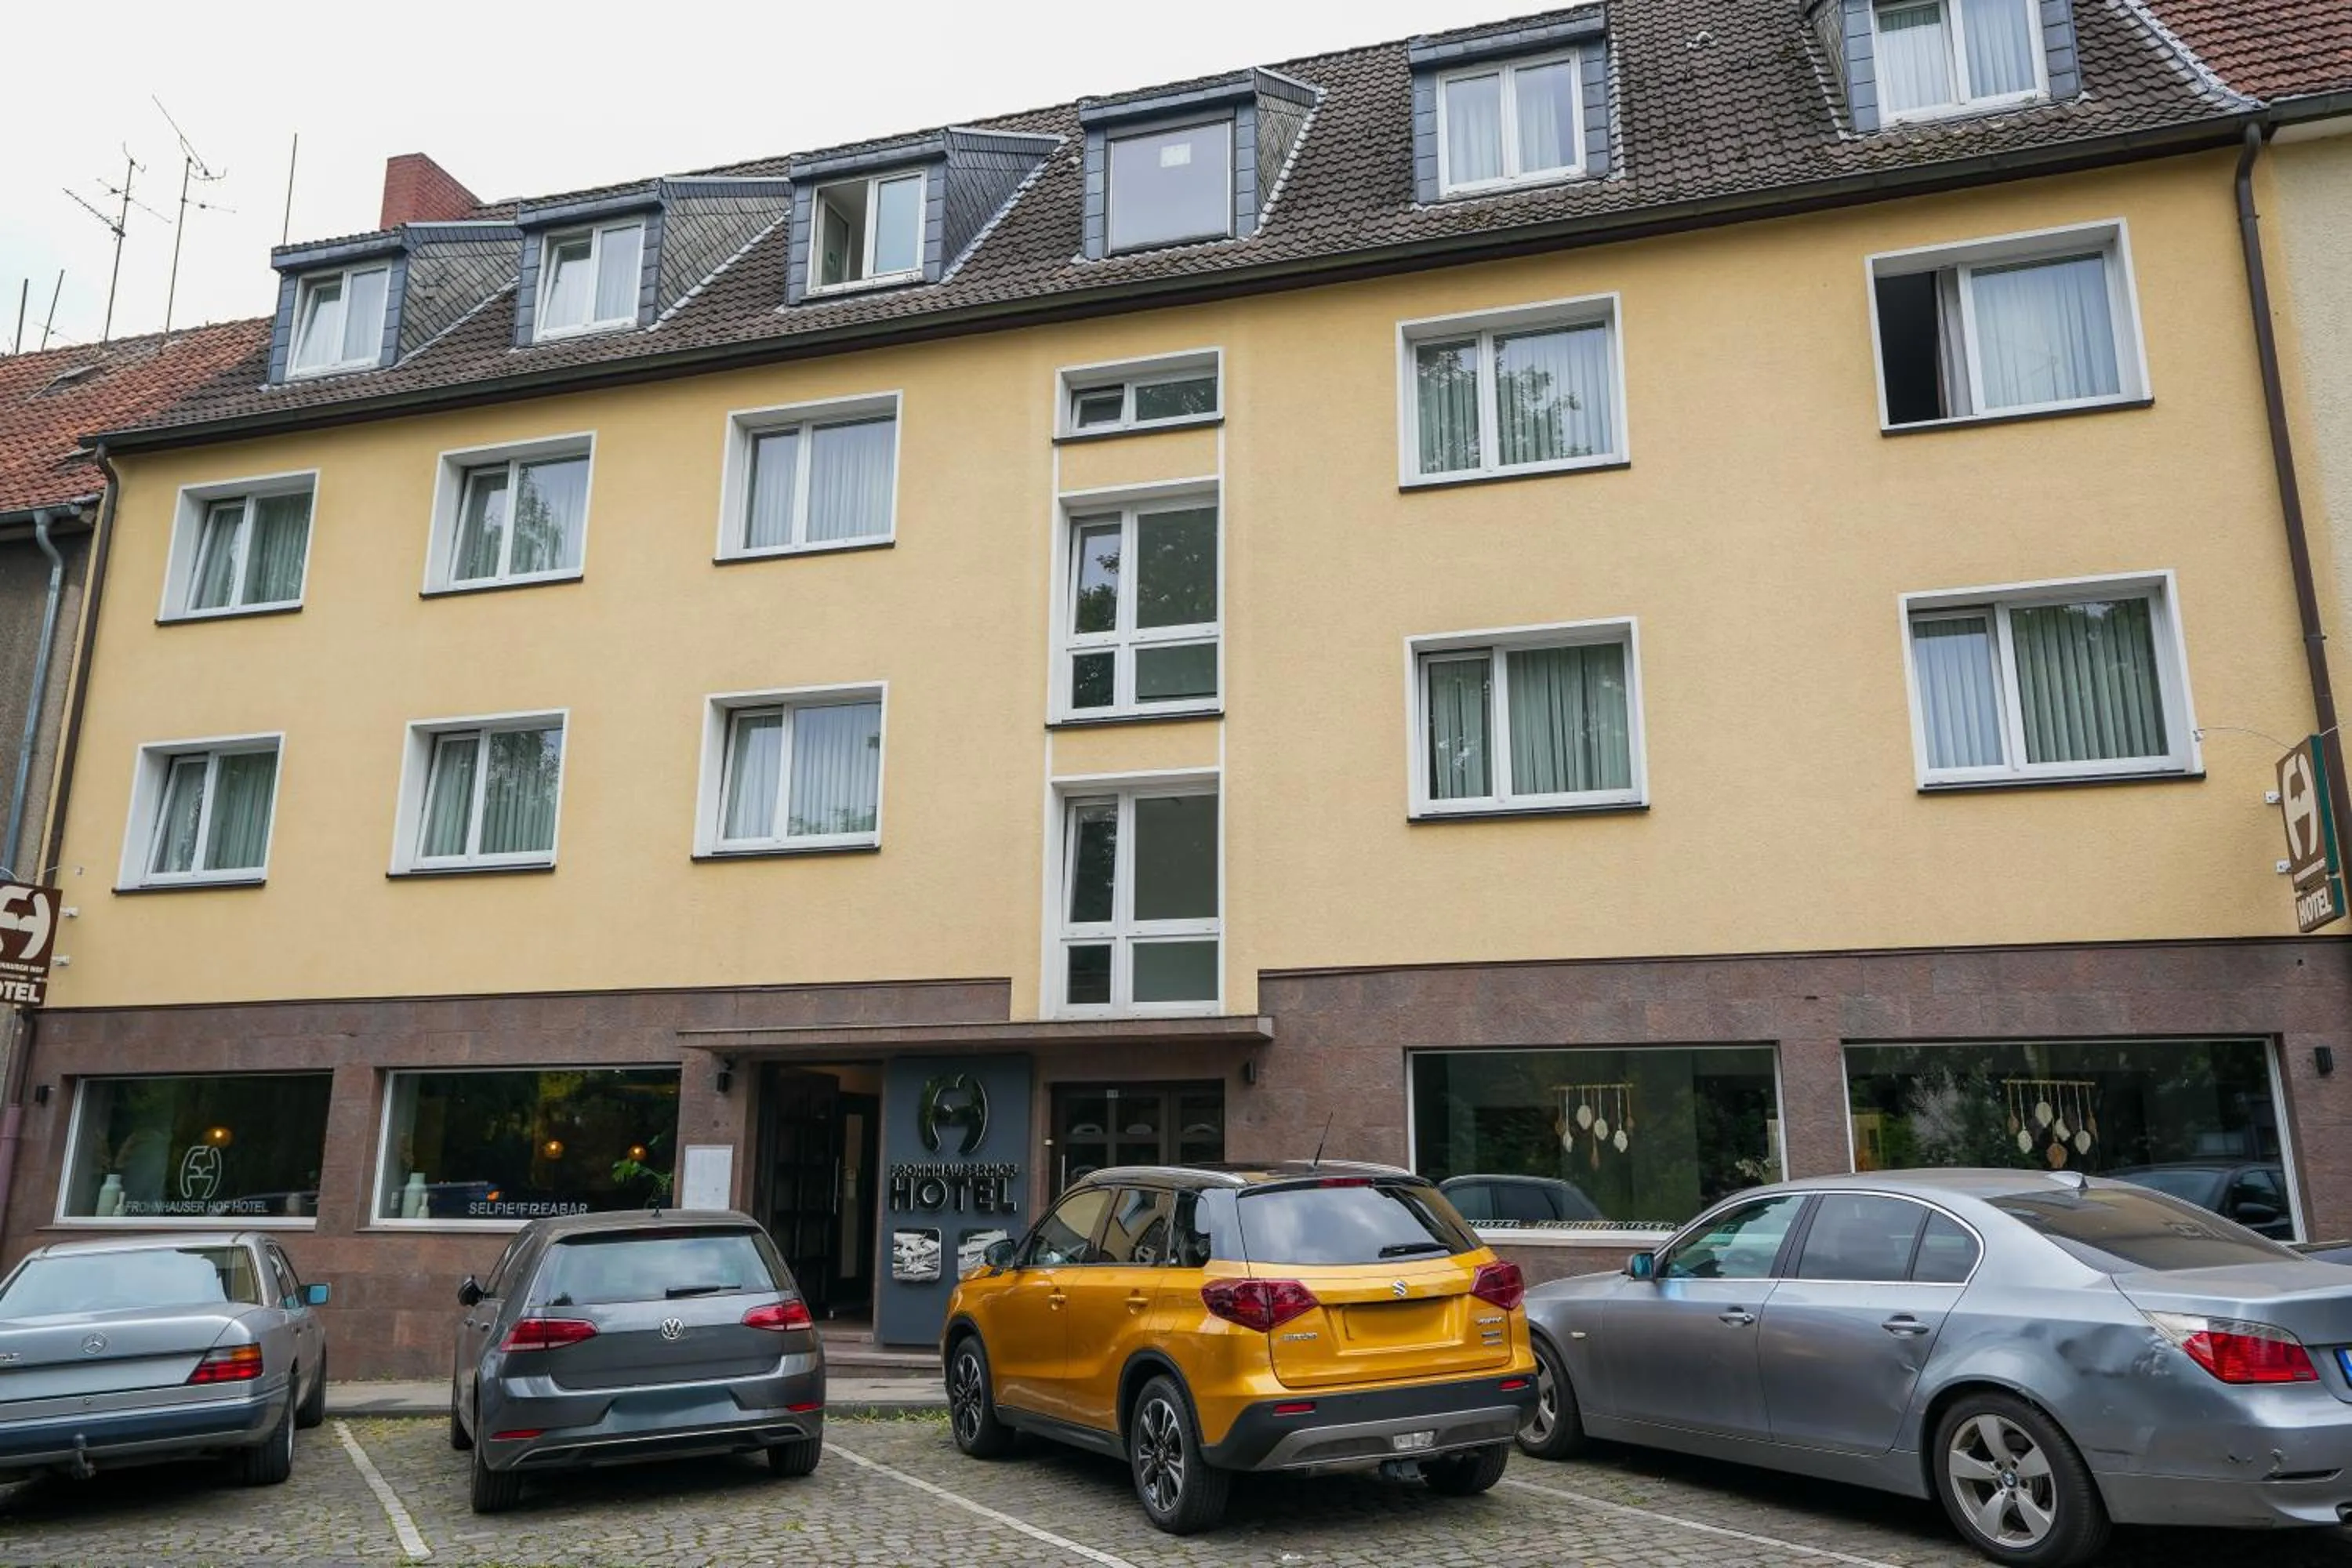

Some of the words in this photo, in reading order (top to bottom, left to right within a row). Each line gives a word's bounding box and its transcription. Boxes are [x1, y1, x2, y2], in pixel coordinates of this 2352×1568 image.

[2298, 887, 2332, 927] HOTEL
[125, 1200, 205, 1214] FROHNHAUSER
[207, 1200, 230, 1214] HOF
[231, 1200, 270, 1214] HOTEL
[889, 1177, 1018, 1212] HOTEL
